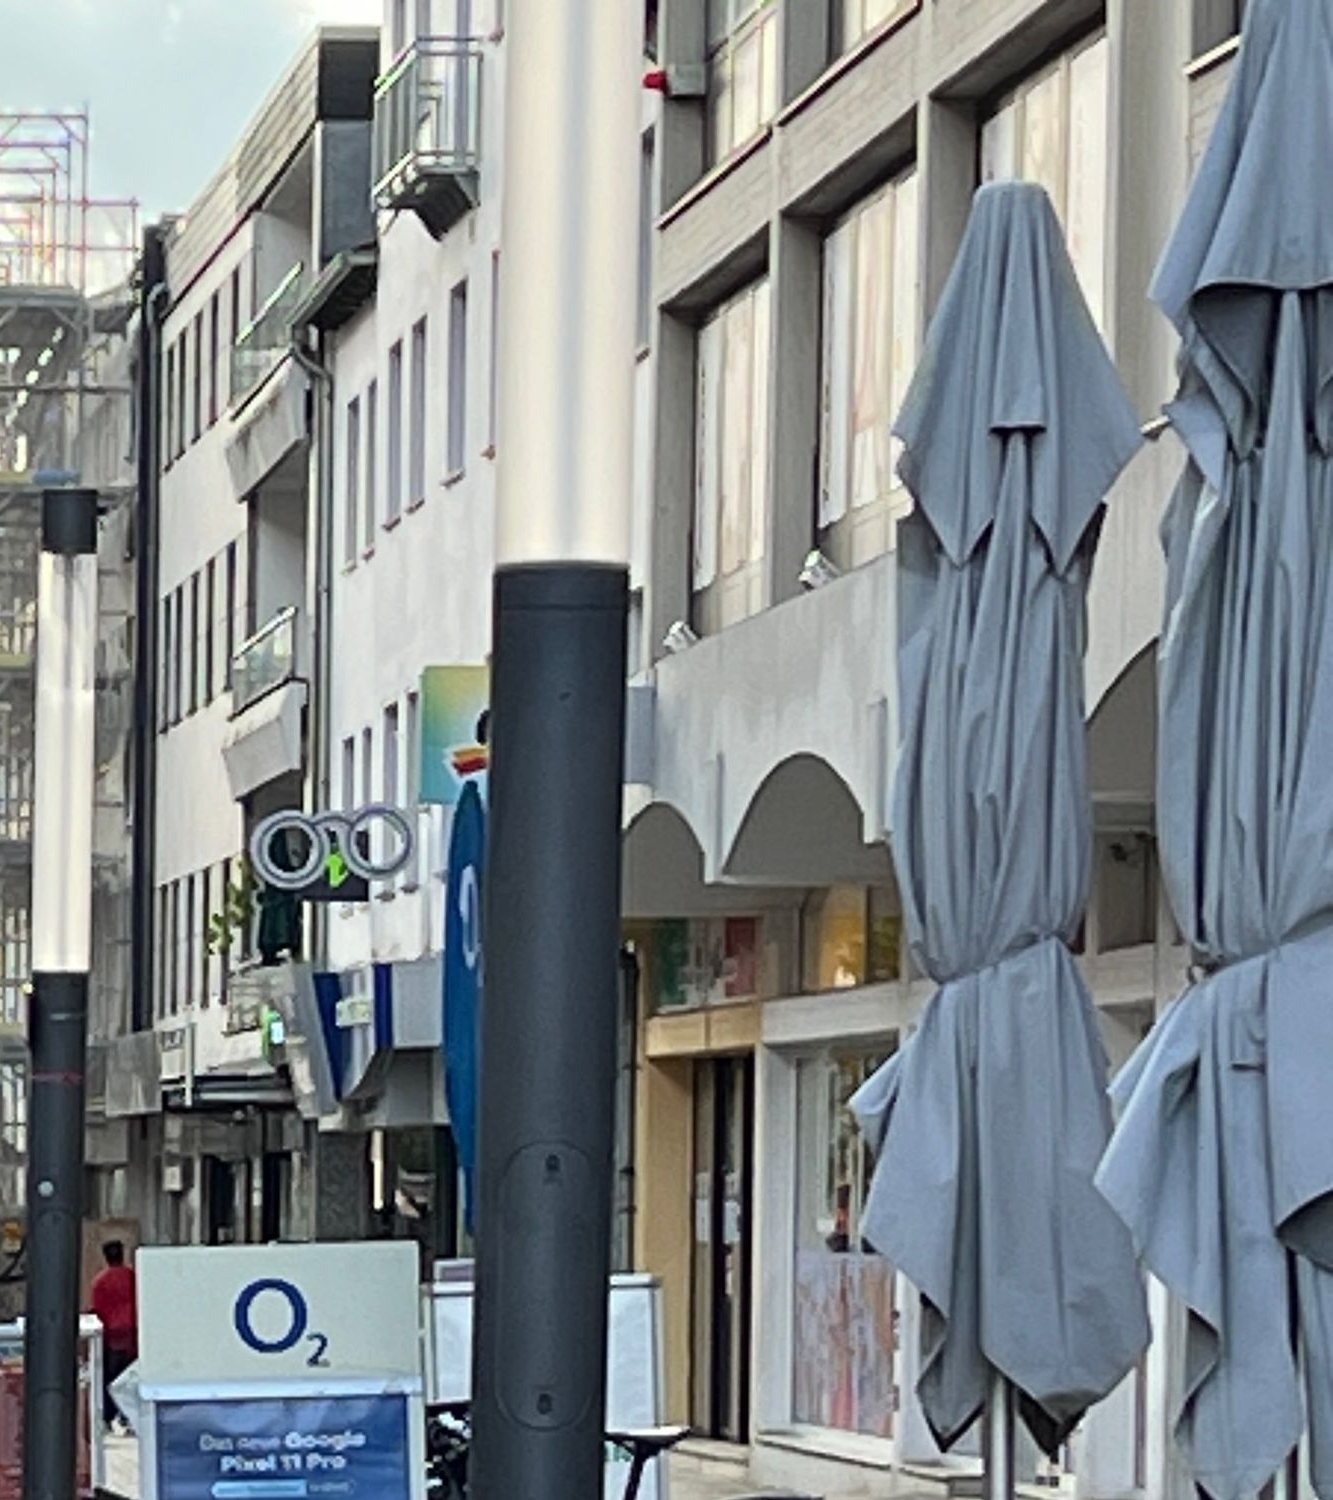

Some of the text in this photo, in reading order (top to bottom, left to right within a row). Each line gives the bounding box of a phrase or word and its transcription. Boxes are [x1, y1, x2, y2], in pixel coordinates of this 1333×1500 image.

[235, 1278, 331, 1368] O2
[285, 1430, 366, 1451] Google
[220, 1454, 277, 1472] Pixel
[306, 1452, 347, 1471] Pro
